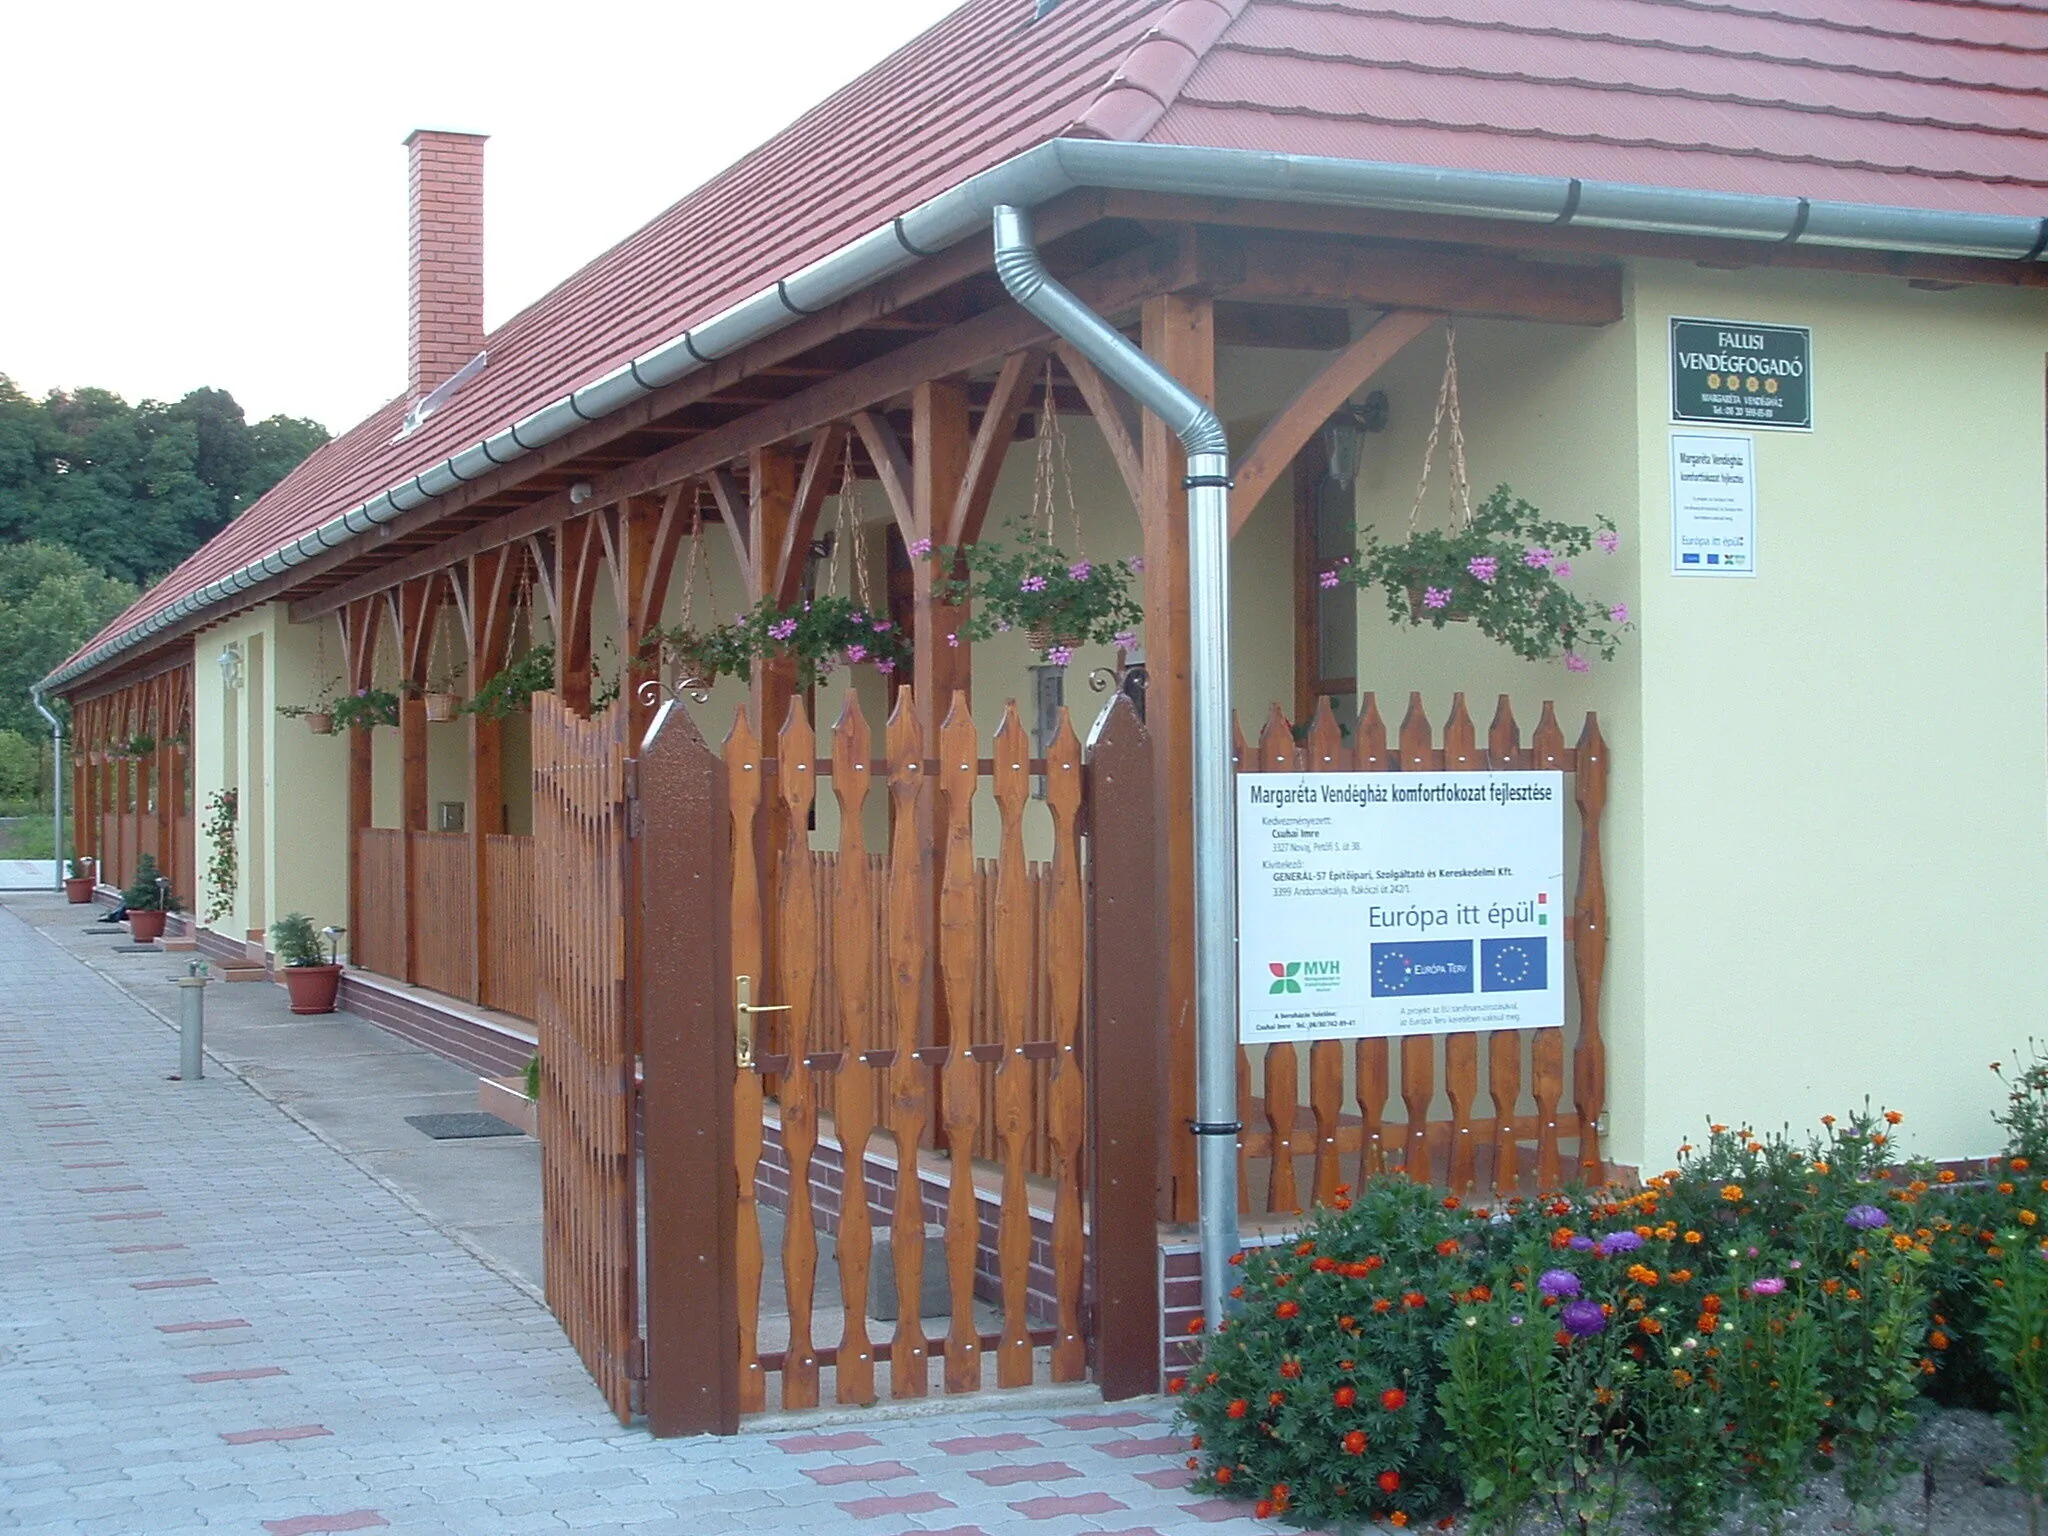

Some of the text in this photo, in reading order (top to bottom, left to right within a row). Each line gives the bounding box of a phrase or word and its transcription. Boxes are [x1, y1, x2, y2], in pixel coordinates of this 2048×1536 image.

[1718, 332, 1764, 350] FALUSI
[1678, 350, 1804, 377] VENDÉGFOGADÓ
[1250, 781, 1553, 808] Margaréta Vendégház komfortfokozat fejlesztése
[1300, 828, 1320, 838] Imre
[1273, 870, 1326, 882] GENERÁL-57
[1376, 868, 1424, 882] Szolgáltató
[1426, 867, 1436, 878] és
[1439, 867, 1496, 878] Kereskedelmi
[1498, 866, 1513, 877] Kft.
[1368, 900, 1534, 932] Európa itt épül
[1304, 960, 1340, 976] MVH
